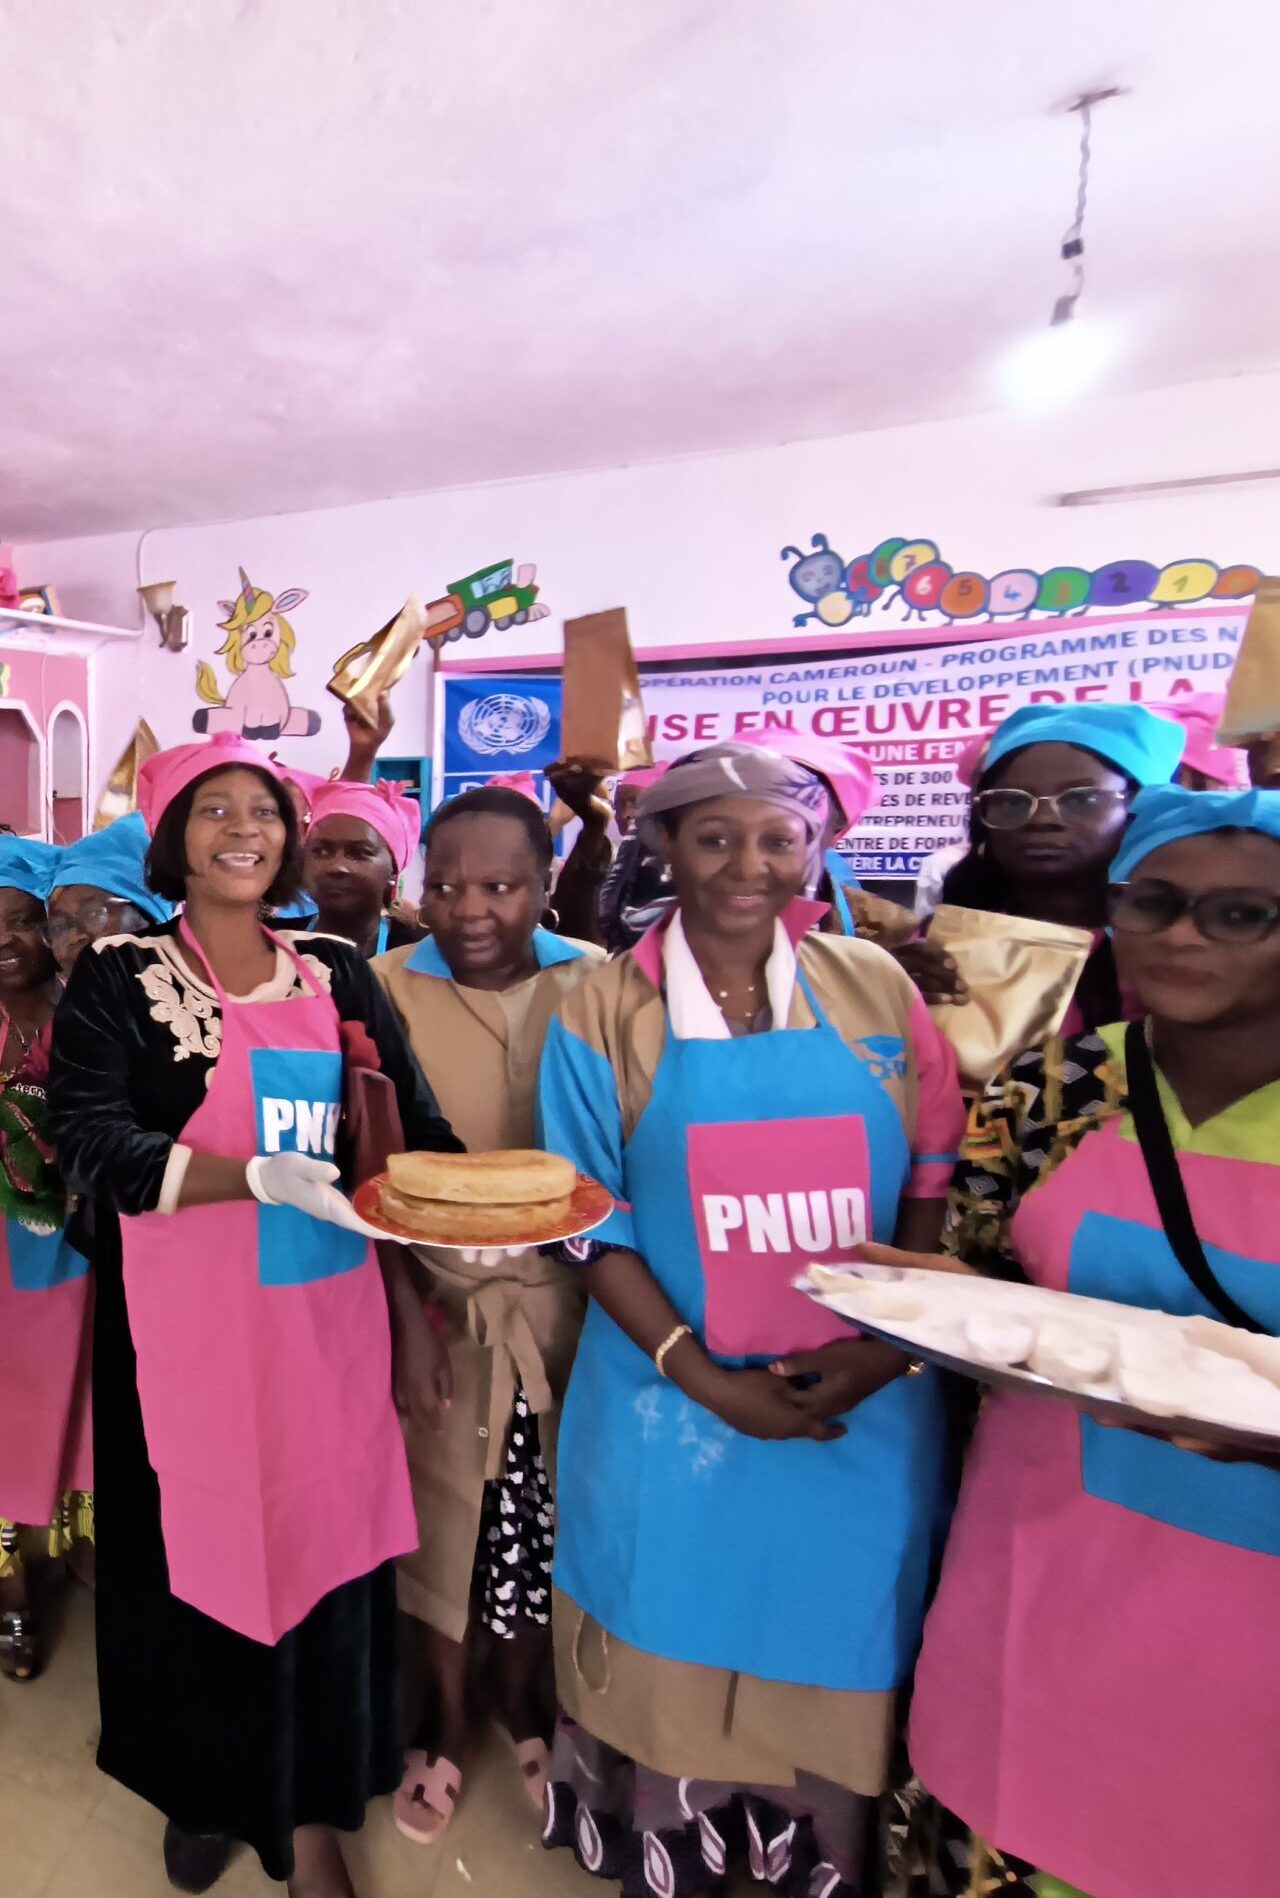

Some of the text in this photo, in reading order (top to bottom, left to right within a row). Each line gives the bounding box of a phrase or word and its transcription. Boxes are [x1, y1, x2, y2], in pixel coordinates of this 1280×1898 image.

[915, 575, 933, 596] 6
[958, 578, 973, 597] 5
[1003, 585, 1023, 600] 4
[1108, 571, 1131, 594] 2
[1172, 574, 1190, 594] 1
[769, 658, 917, 685] CAMEROUN
[941, 630, 1139, 667] PROGRAMME
[1147, 627, 1208, 646] DES
[1217, 626, 1239, 643] N
[761, 651, 1235, 706] POUR LE DÉVELOPPEMENT (PNUD
[734, 709, 794, 733] EN
[811, 693, 1012, 738] ŒUVRE
[871, 743, 919, 762] UNE
[874, 770, 953, 786] S DE 300
[905, 794, 926, 807] DE
[888, 837, 910, 850] DE
[885, 857, 905, 871] LA
[702, 1187, 867, 1254] PNUD
